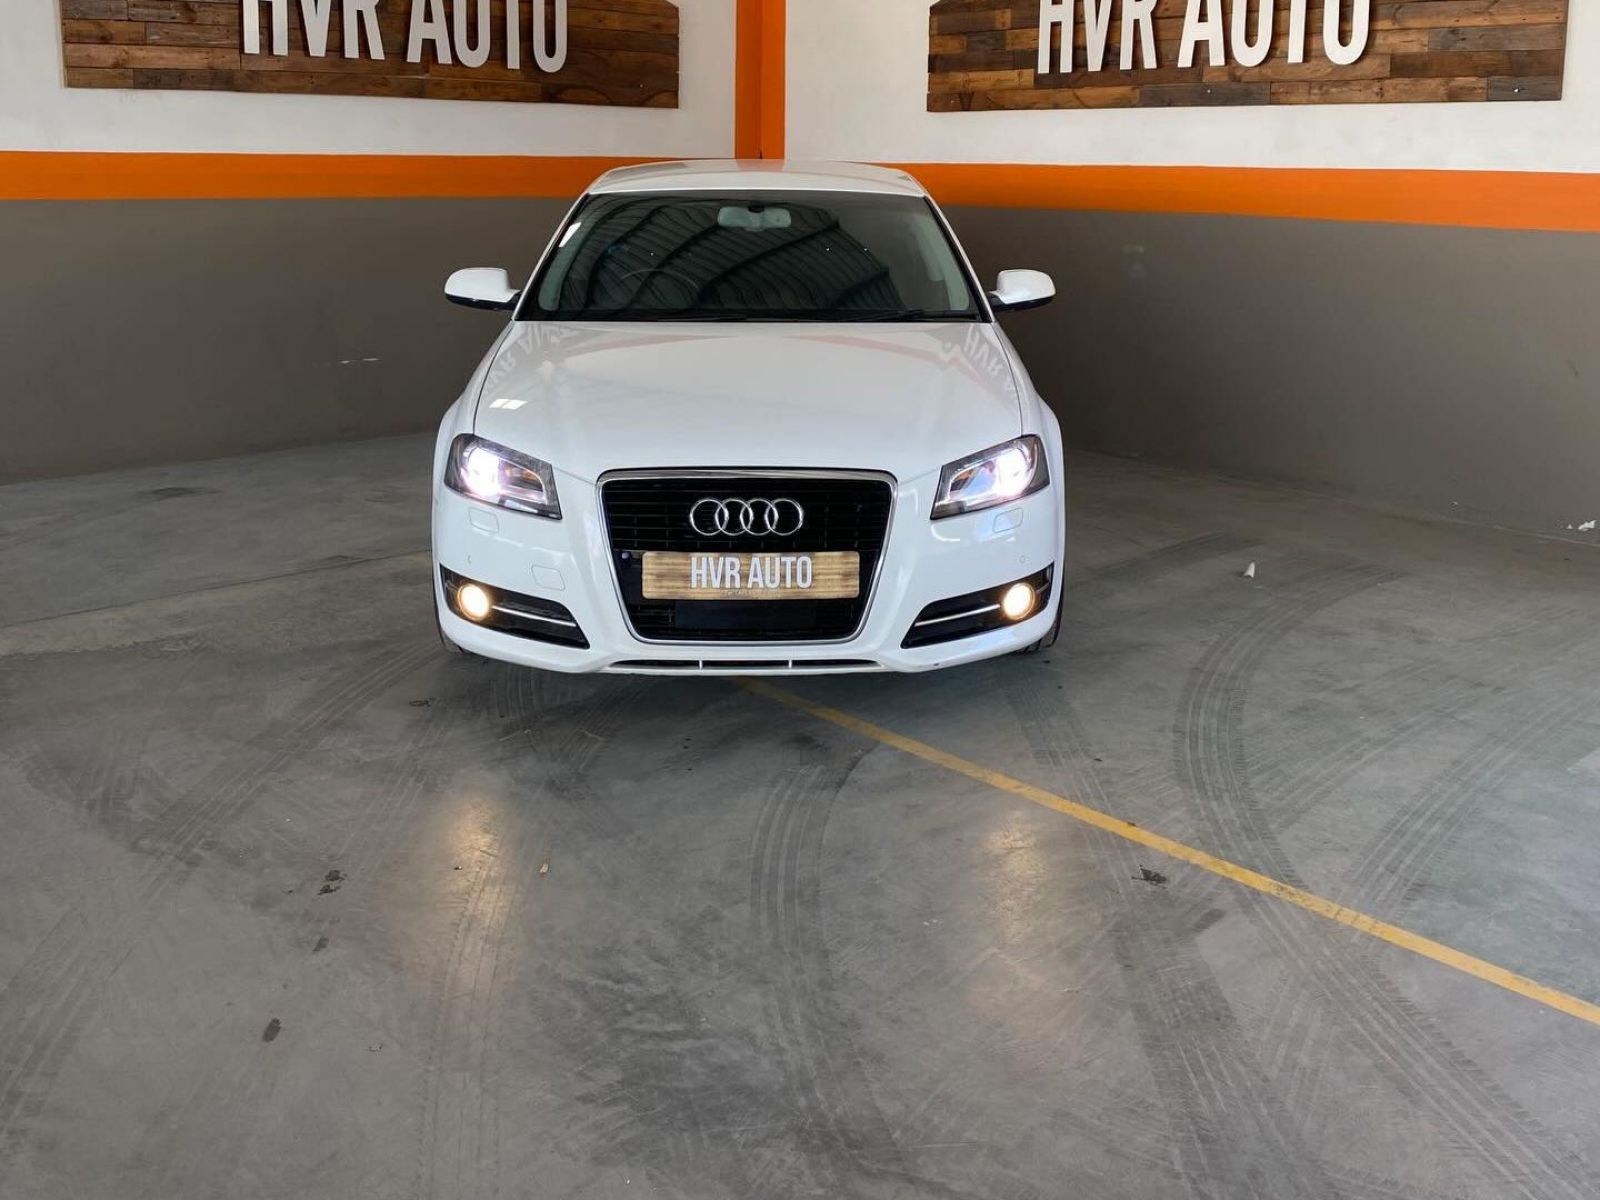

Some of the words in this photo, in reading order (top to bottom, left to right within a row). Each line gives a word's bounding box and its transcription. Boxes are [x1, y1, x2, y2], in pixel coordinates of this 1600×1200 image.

[1037, 0, 1157, 74] HVR
[690, 556, 741, 589] HVR
[747, 556, 813, 589] AUTO
